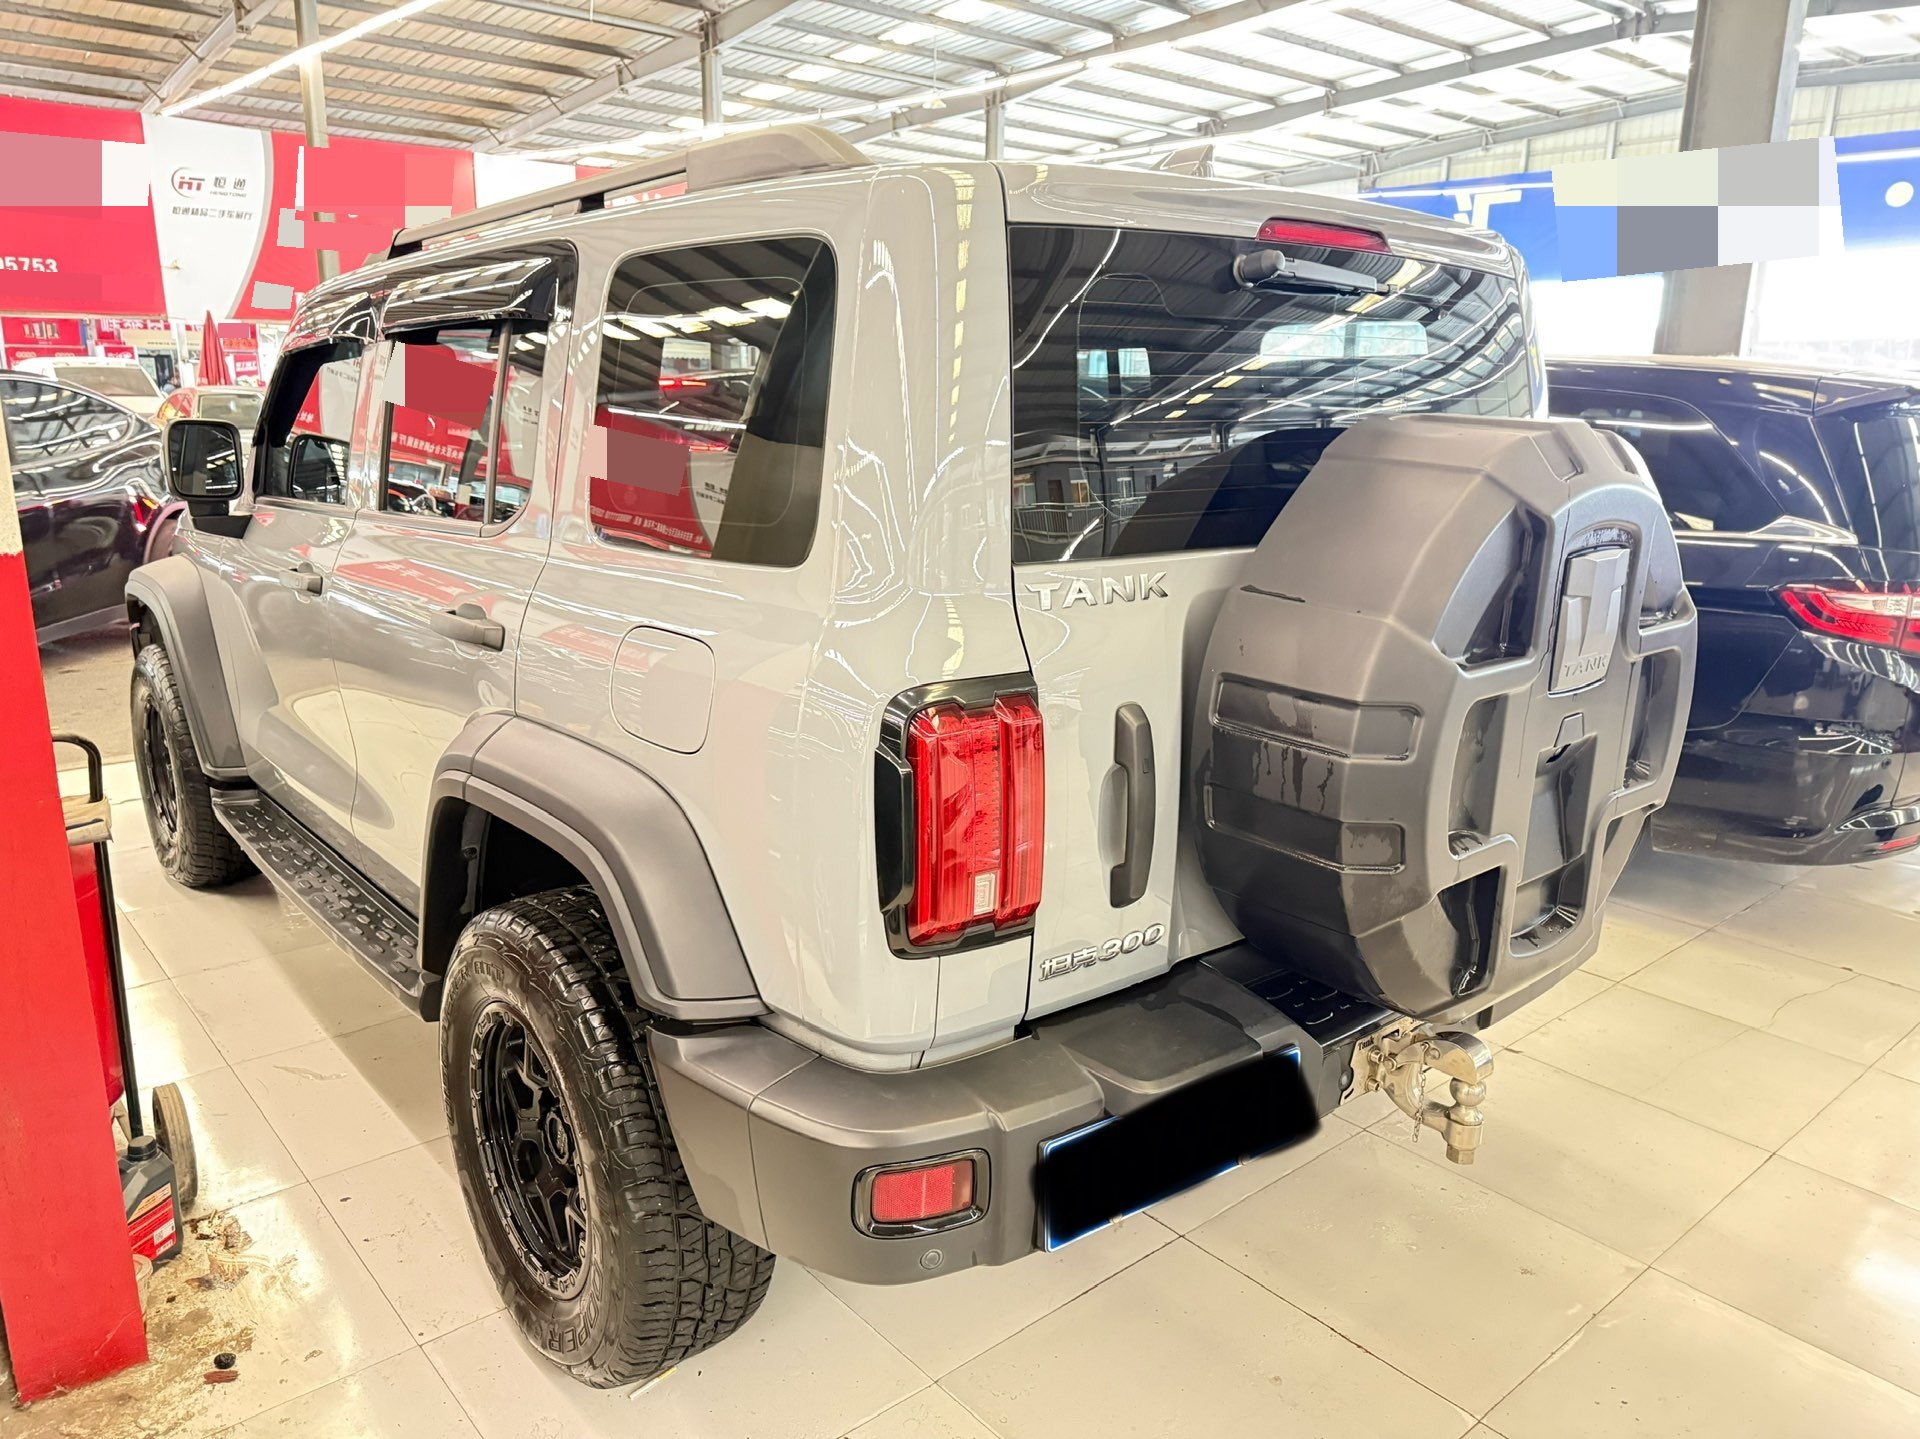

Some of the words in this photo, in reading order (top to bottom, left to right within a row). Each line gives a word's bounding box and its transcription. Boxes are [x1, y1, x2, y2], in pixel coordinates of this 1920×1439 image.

[1024, 570, 1169, 611] TANK
[1562, 654, 1608, 679] TANK
[1038, 922, 1166, 983] 坦克300
[548, 1220, 604, 1355] COOPER
